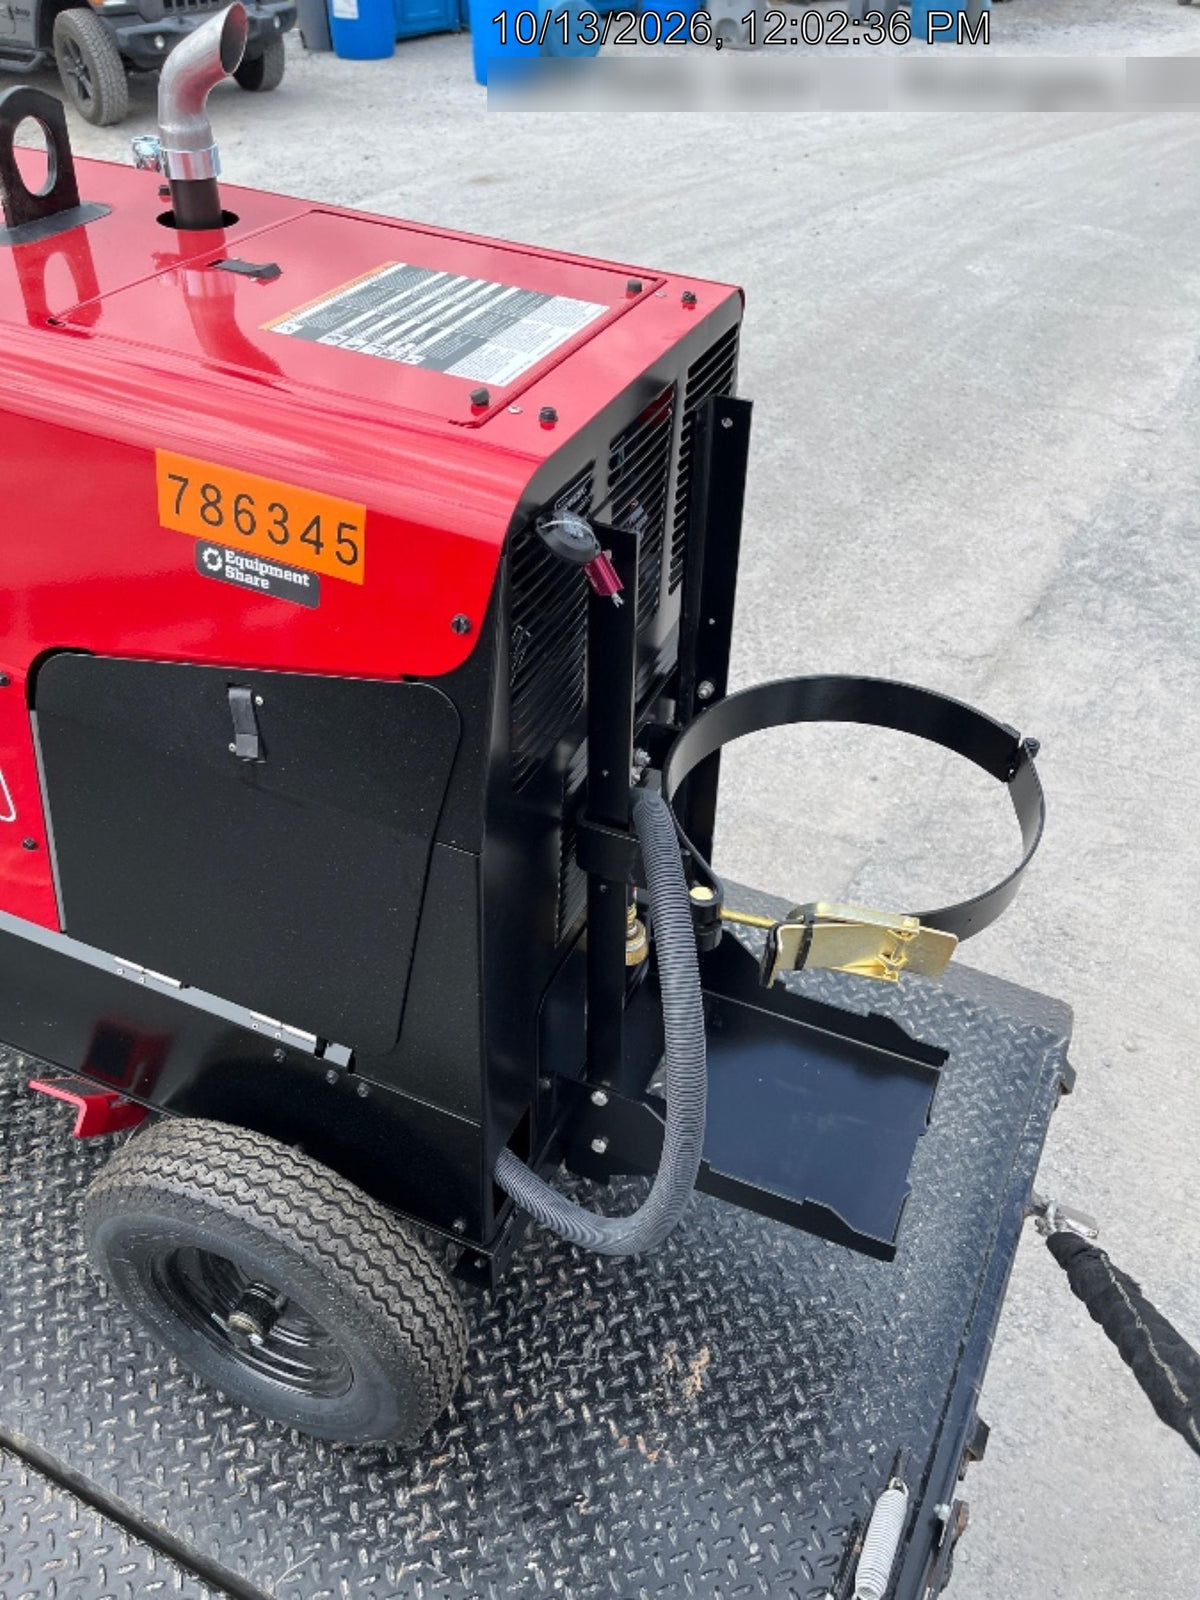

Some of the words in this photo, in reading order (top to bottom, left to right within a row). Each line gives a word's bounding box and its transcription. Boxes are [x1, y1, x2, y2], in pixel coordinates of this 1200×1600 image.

[167, 473, 359, 566] 786345
[224, 549, 310, 587] Equipment
[224, 564, 270, 589] Share
